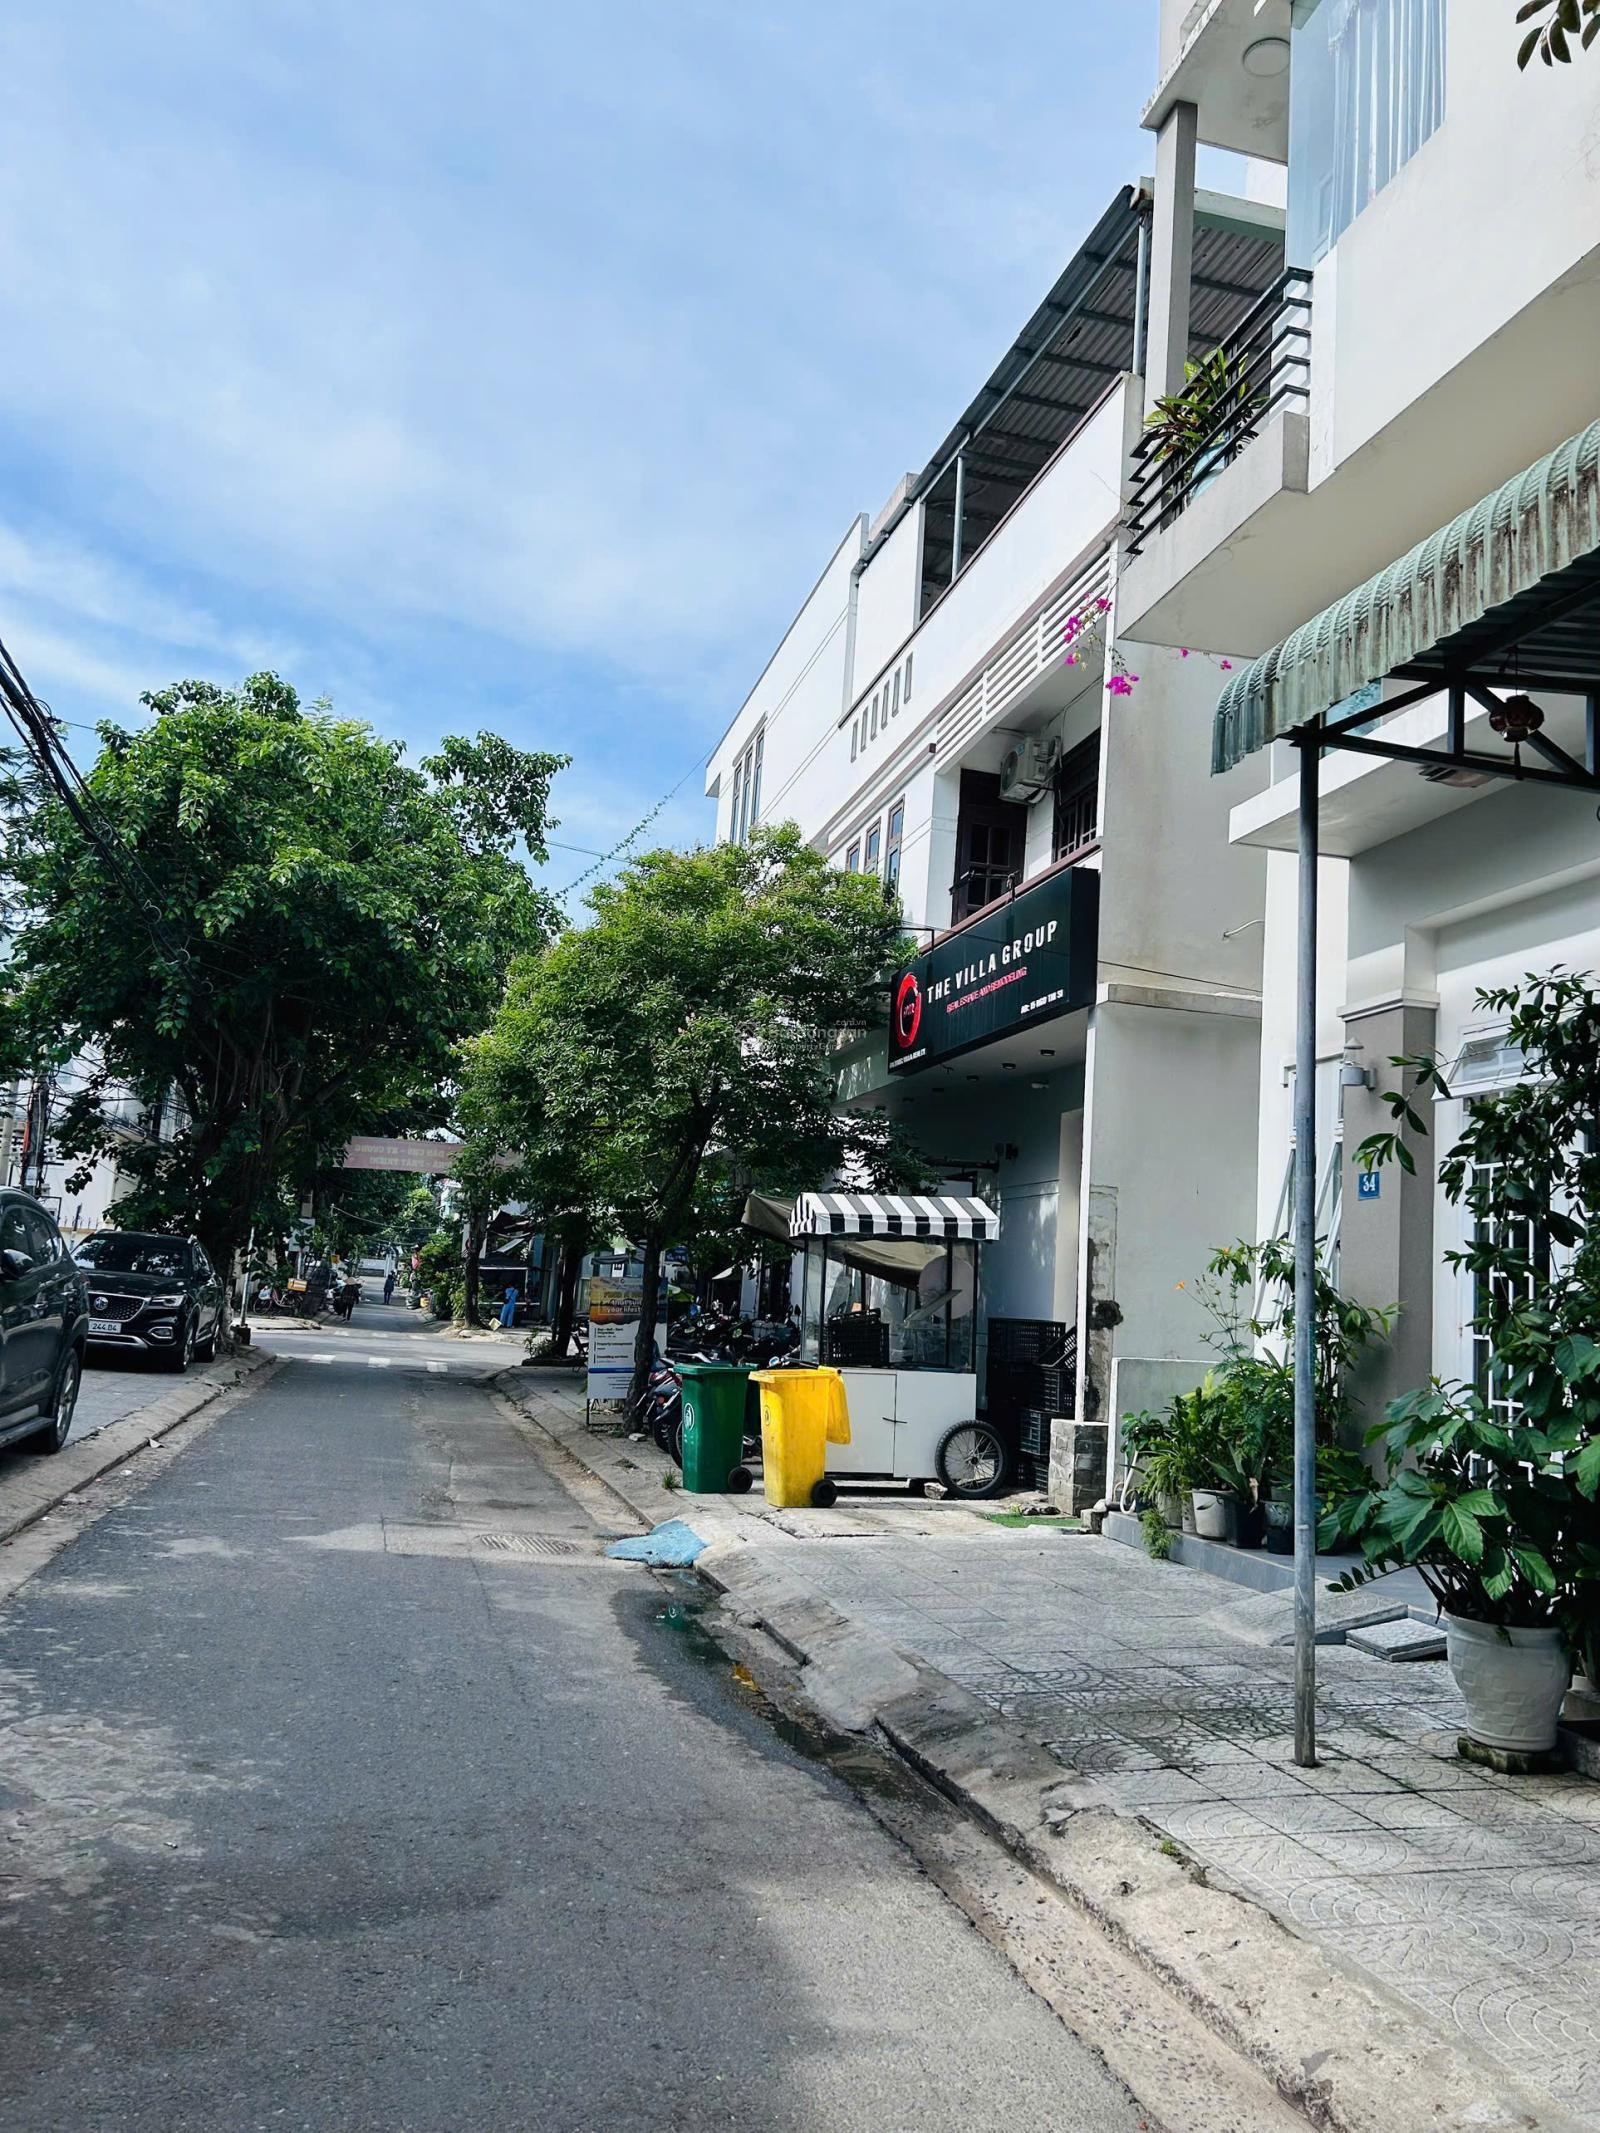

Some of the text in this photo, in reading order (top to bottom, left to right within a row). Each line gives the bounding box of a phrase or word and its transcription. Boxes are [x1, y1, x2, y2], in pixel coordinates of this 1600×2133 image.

[927, 920, 1058, 1004] THE VILLA GROUP
[1363, 1173, 1376, 1191] 34
